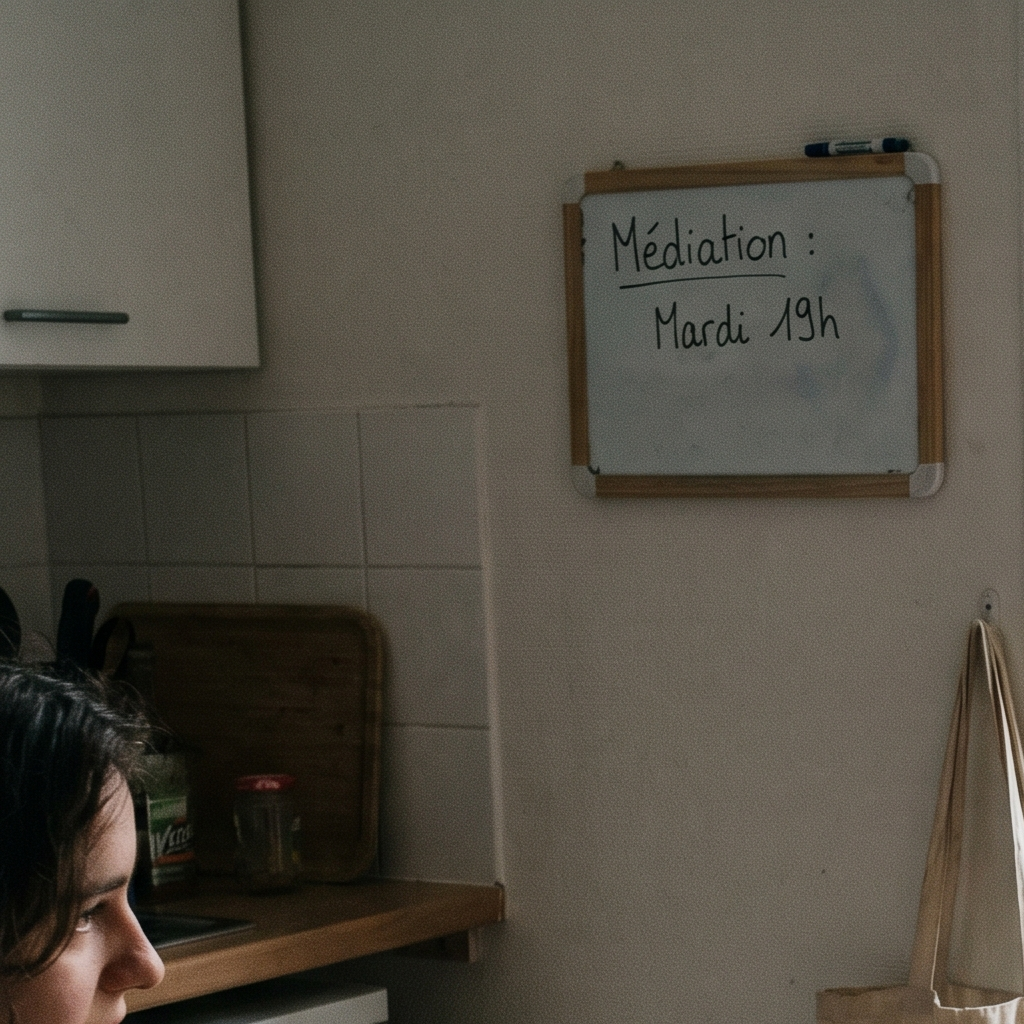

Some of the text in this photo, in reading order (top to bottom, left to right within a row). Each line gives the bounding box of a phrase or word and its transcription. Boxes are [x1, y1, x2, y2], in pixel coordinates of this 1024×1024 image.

[611, 214, 787, 272] Médiation
[654, 295, 840, 350] Mardi 19h
